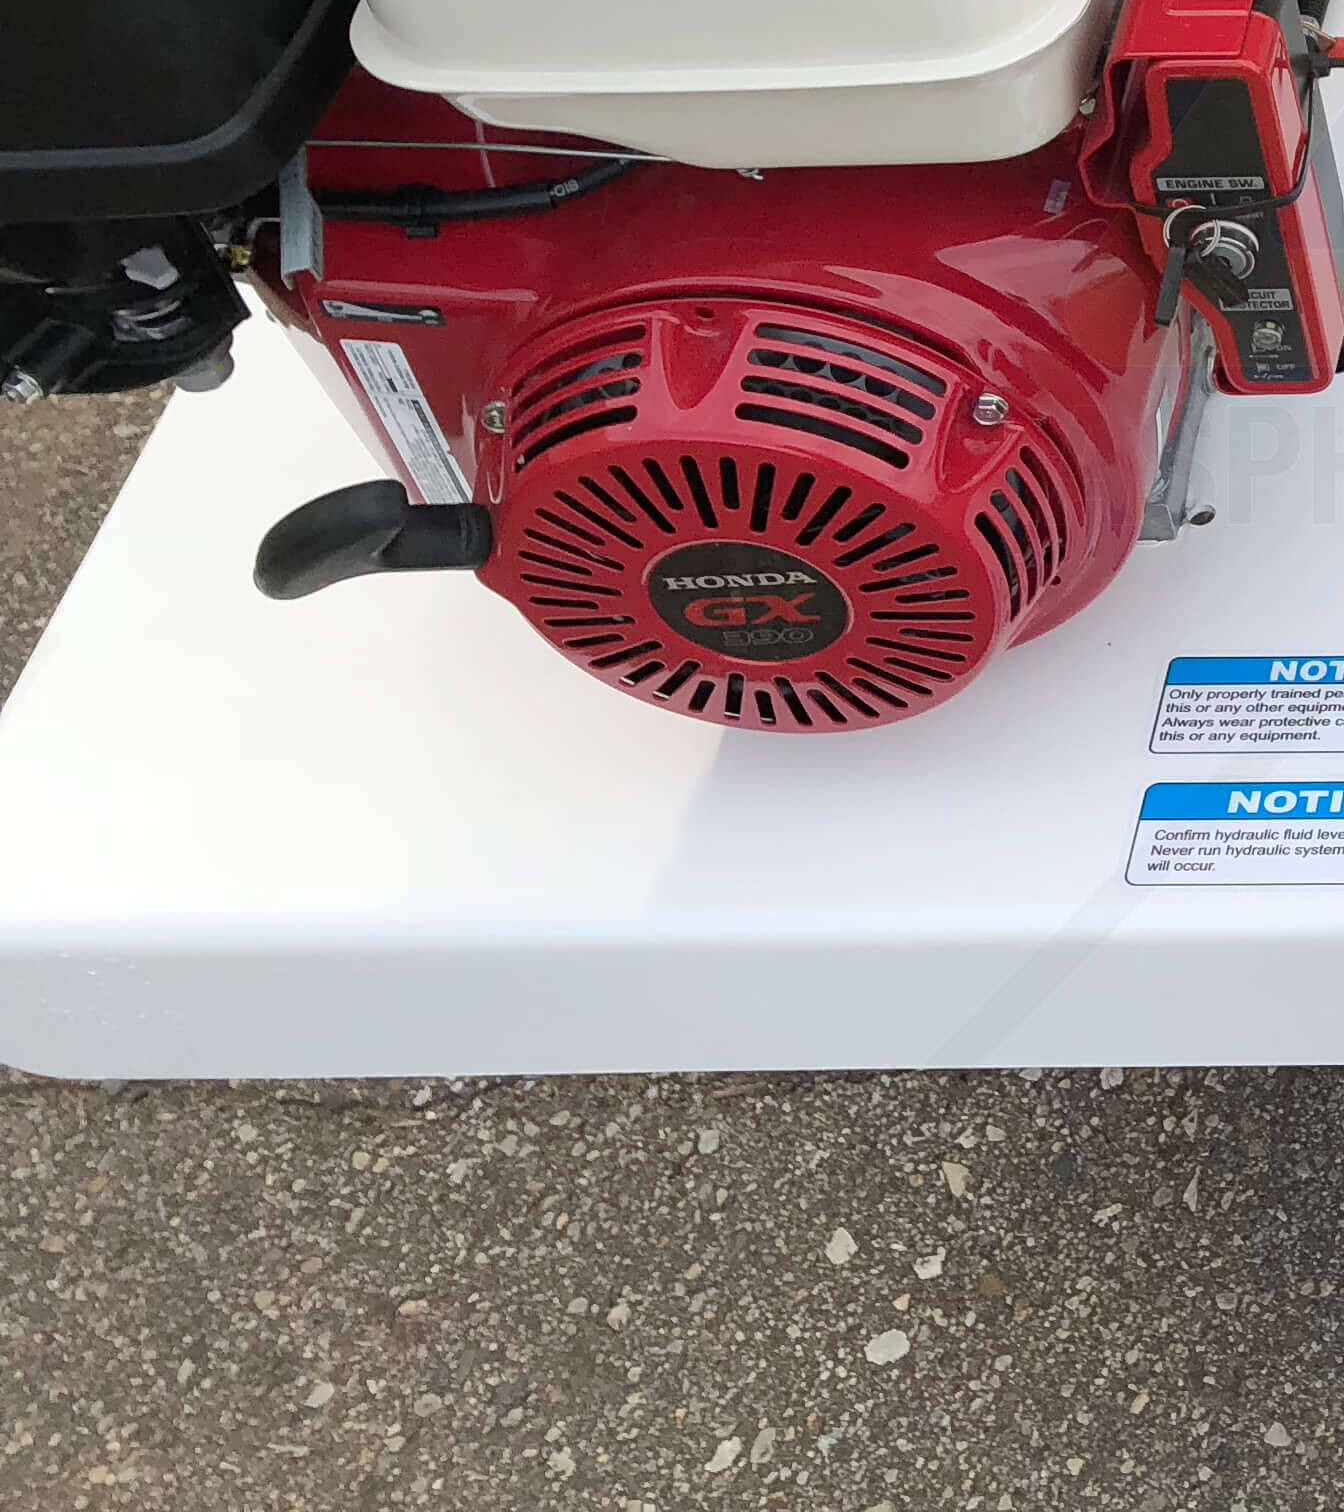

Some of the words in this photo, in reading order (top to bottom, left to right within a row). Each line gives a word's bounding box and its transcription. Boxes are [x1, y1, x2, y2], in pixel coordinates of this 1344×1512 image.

[1166, 178, 1224, 190] ENGINE
[663, 572, 817, 590] HONDA
[684, 593, 821, 627] GX
[721, 627, 814, 646] 390
[1169, 688, 1203, 701] Only
[1206, 687, 1267, 701] properly
[1271, 687, 1321, 699] trained
[1165, 701, 1192, 713] this
[1195, 704, 1211, 713] or
[1214, 703, 1242, 715] any
[1246, 701, 1284, 713] other
[1161, 716, 1215, 729] Always
[1218, 718, 1254, 728] wear
[1258, 715, 1330, 729] protective
[1159, 730, 1185, 742] this
[1188, 732, 1204, 742] or
[1208, 732, 1236, 744] any
[1239, 730, 1321, 744] equipment.
[1154, 829, 1210, 842] Confirm
[1214, 828, 1280, 844] hydraulic
[1284, 828, 1314, 841] fluid
[1150, 844, 1194, 857] Never
[1198, 847, 1221, 857] run
[1225, 843, 1291, 859] hydraulic
[1294, 845, 1344, 859] system
[1147, 860, 1170, 872] will
[1174, 862, 1216, 872] occur.
